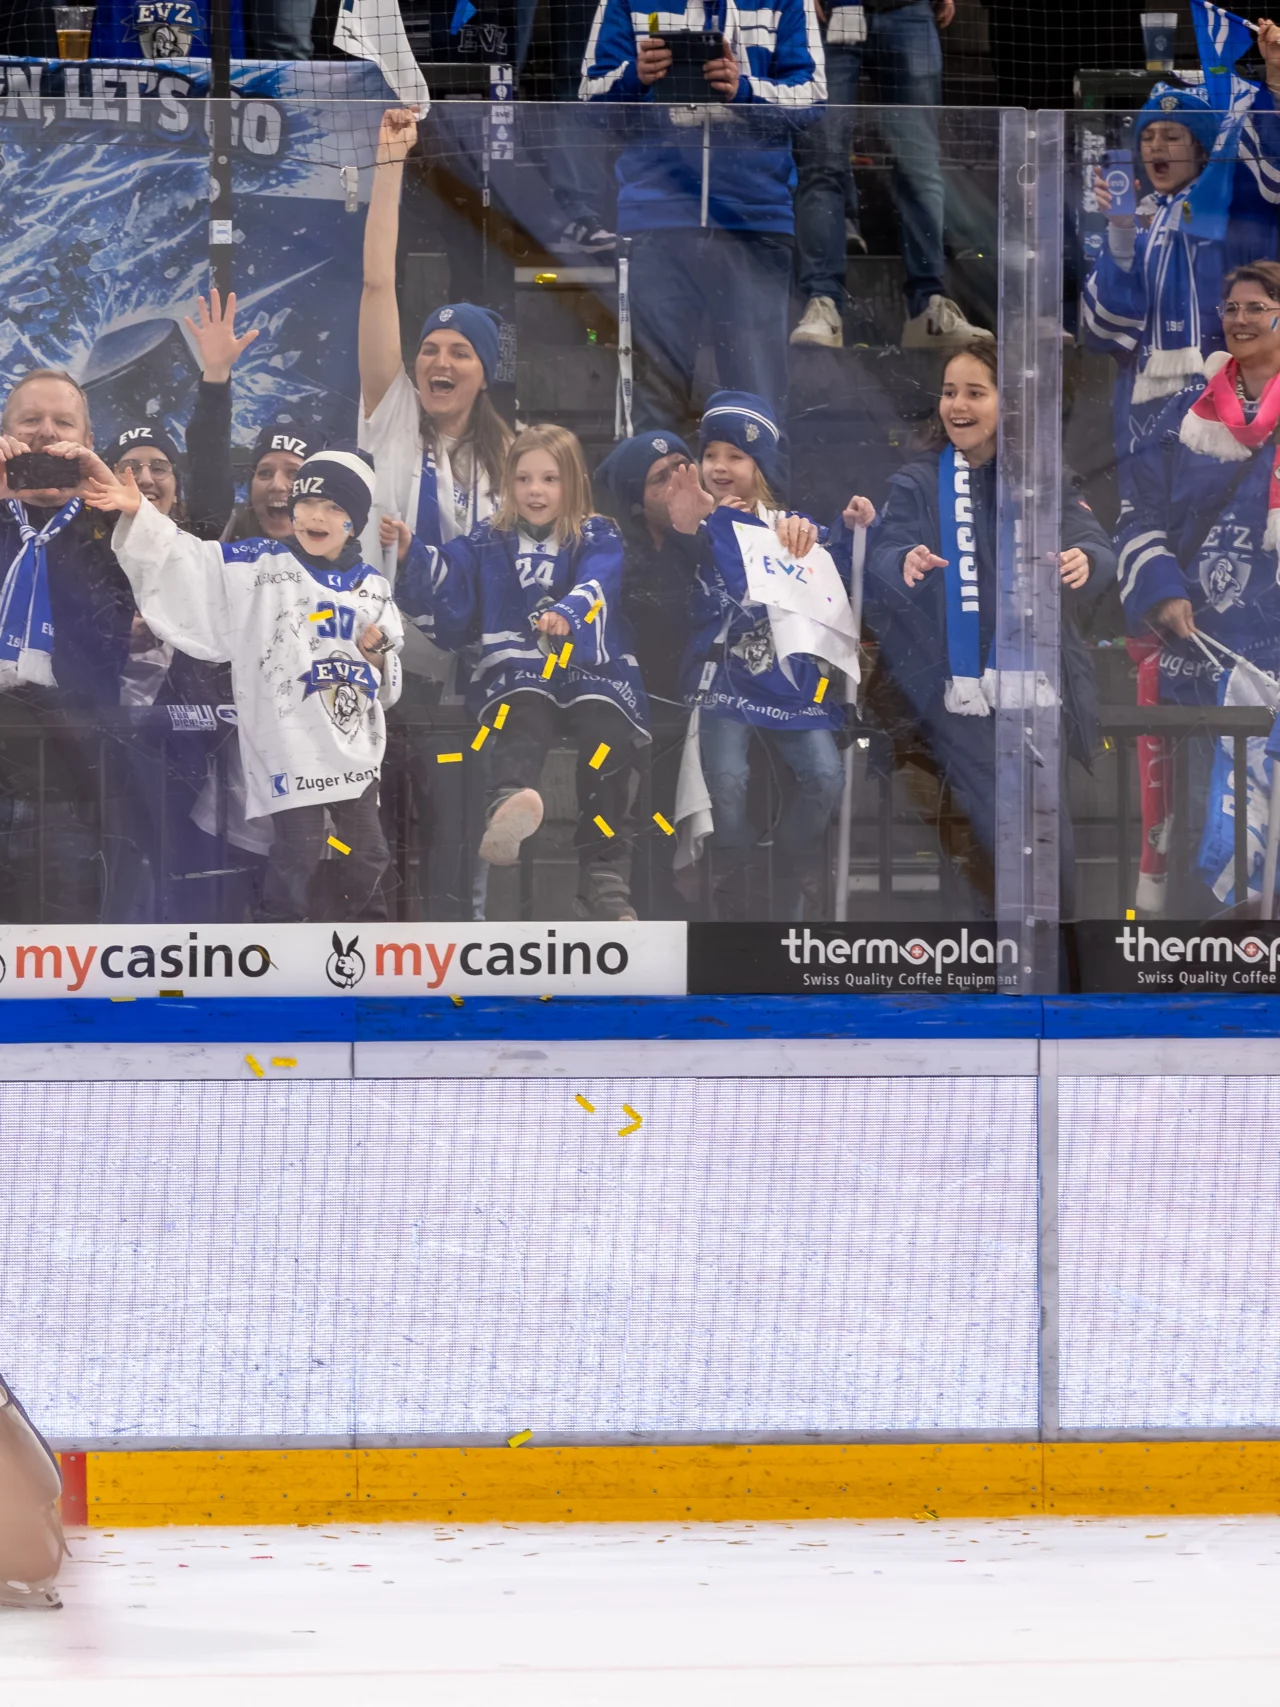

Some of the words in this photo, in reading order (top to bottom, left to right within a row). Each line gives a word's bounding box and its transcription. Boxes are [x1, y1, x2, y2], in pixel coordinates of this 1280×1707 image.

[137, 3, 193, 24] EVZ
[65, 66, 193, 132] LET'S
[118, 427, 154, 446] EVZ
[271, 434, 308, 457] EVZ
[292, 477, 325, 497] EVZ
[1200, 524, 1254, 550] EZ
[515, 557, 556, 589] 24
[762, 555, 808, 585] EVZ
[315, 600, 357, 641] 30
[315, 661, 370, 685] EVZ
[514, 670, 549, 683] Zug
[1159, 652, 1205, 678] uger
[295, 773, 342, 792] Zuger
[15, 931, 272, 991] mycasino
[375, 929, 630, 990] mycasino
[780, 928, 1019, 975] thermoplan
[803, 973, 840, 986] Swiss
[844, 973, 894, 988] Quality
[898, 973, 943, 986] Coffee
[947, 973, 1019, 988] Equipment
[1137, 971, 1174, 984] Swiss
[1178, 971, 1228, 987] Quality
[1232, 971, 1277, 984] Coffee
